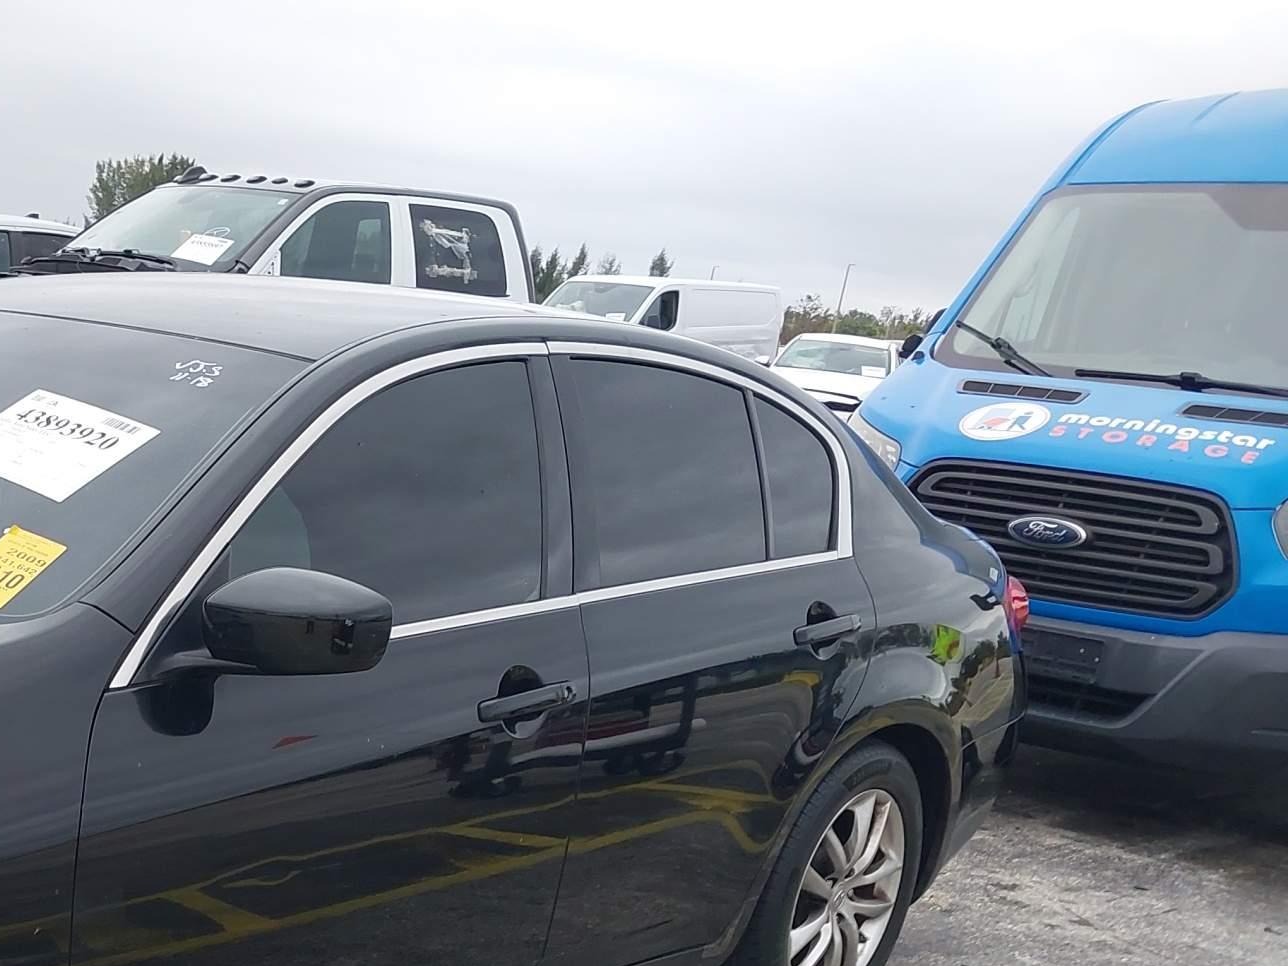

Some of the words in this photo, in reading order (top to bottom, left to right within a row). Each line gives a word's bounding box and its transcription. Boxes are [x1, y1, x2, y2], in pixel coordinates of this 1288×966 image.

[16, 408, 120, 450] 43893920
[1048, 425, 1260, 464] STORAGE
[1057, 413, 1276, 449] morningstar
[1022, 520, 1068, 542] Ford
[6, 547, 47, 568] 2009
